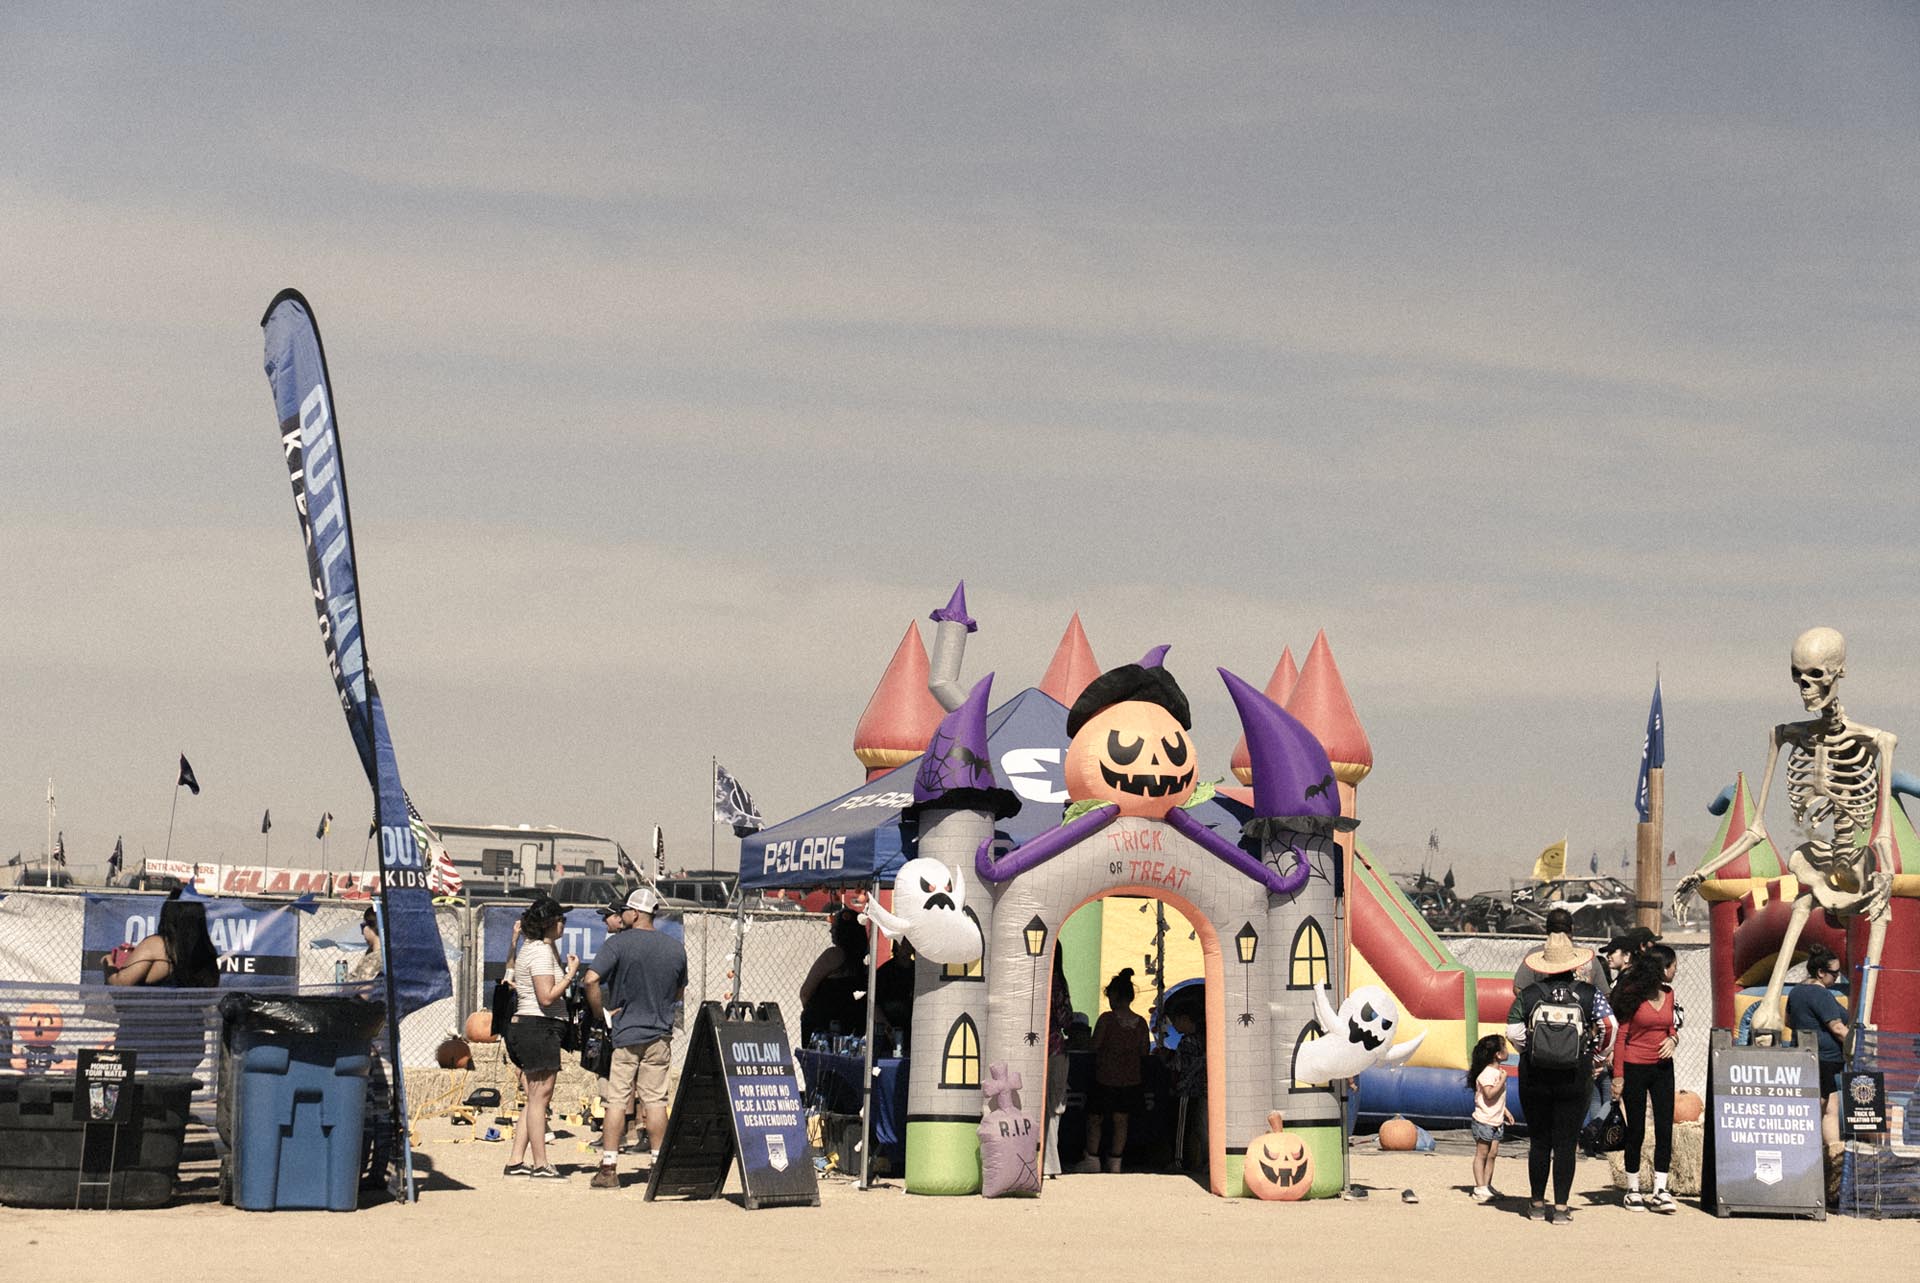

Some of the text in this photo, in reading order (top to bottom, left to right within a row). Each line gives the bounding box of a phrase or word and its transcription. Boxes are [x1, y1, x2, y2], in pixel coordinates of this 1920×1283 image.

[1107, 829, 1163, 852] TRICK
[763, 836, 847, 875] POLARIS
[147, 862, 191, 873] ENTRANCE
[1109, 860, 1192, 889] OR TREAT
[385, 870, 425, 888] KIDS
[732, 1042, 781, 1063] OUTLAW
[736, 1065, 785, 1075] KIDS ZONE
[1730, 1064, 1801, 1085] OUTLAW
[739, 1084, 790, 1097] POR FAVOR NO
[1731, 1086, 1802, 1097] KIDS ZONE
[735, 1097, 800, 1112] DEJE A LOS NIÑOS
[1724, 1102, 1810, 1117] PLEASE DO NOT
[744, 1114, 798, 1127] DESATENDIDOS
[1721, 1117, 1815, 1132] LEAVE CHILDREN
[1731, 1132, 1805, 1145] UNATTENDED
